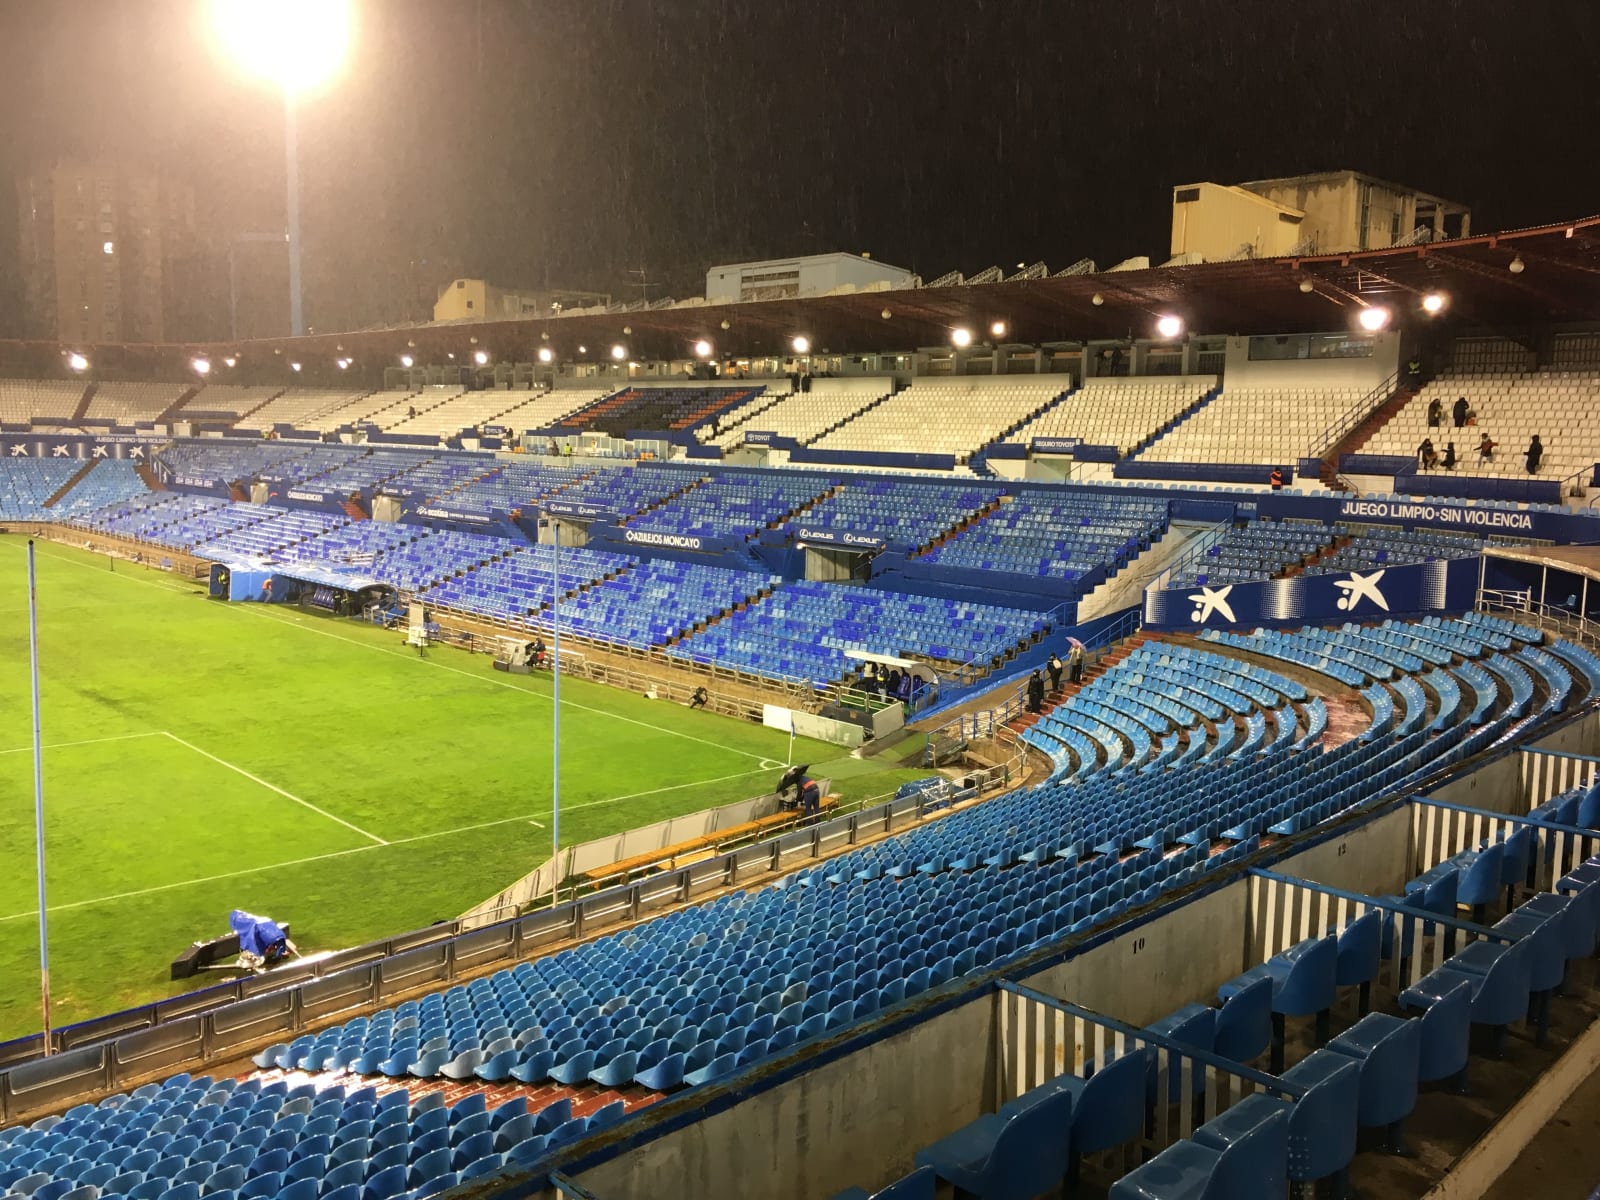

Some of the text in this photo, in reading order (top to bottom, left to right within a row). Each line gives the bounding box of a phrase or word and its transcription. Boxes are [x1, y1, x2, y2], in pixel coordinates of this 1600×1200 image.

[1342, 502, 1388, 516] JUEGO
[1464, 509, 1532, 529] VIOLENCIA
[633, 532, 700, 549] AZULEJOS MONCAYO
[808, 531, 834, 540] LEXUS
[1133, 937, 1145, 954] 10
